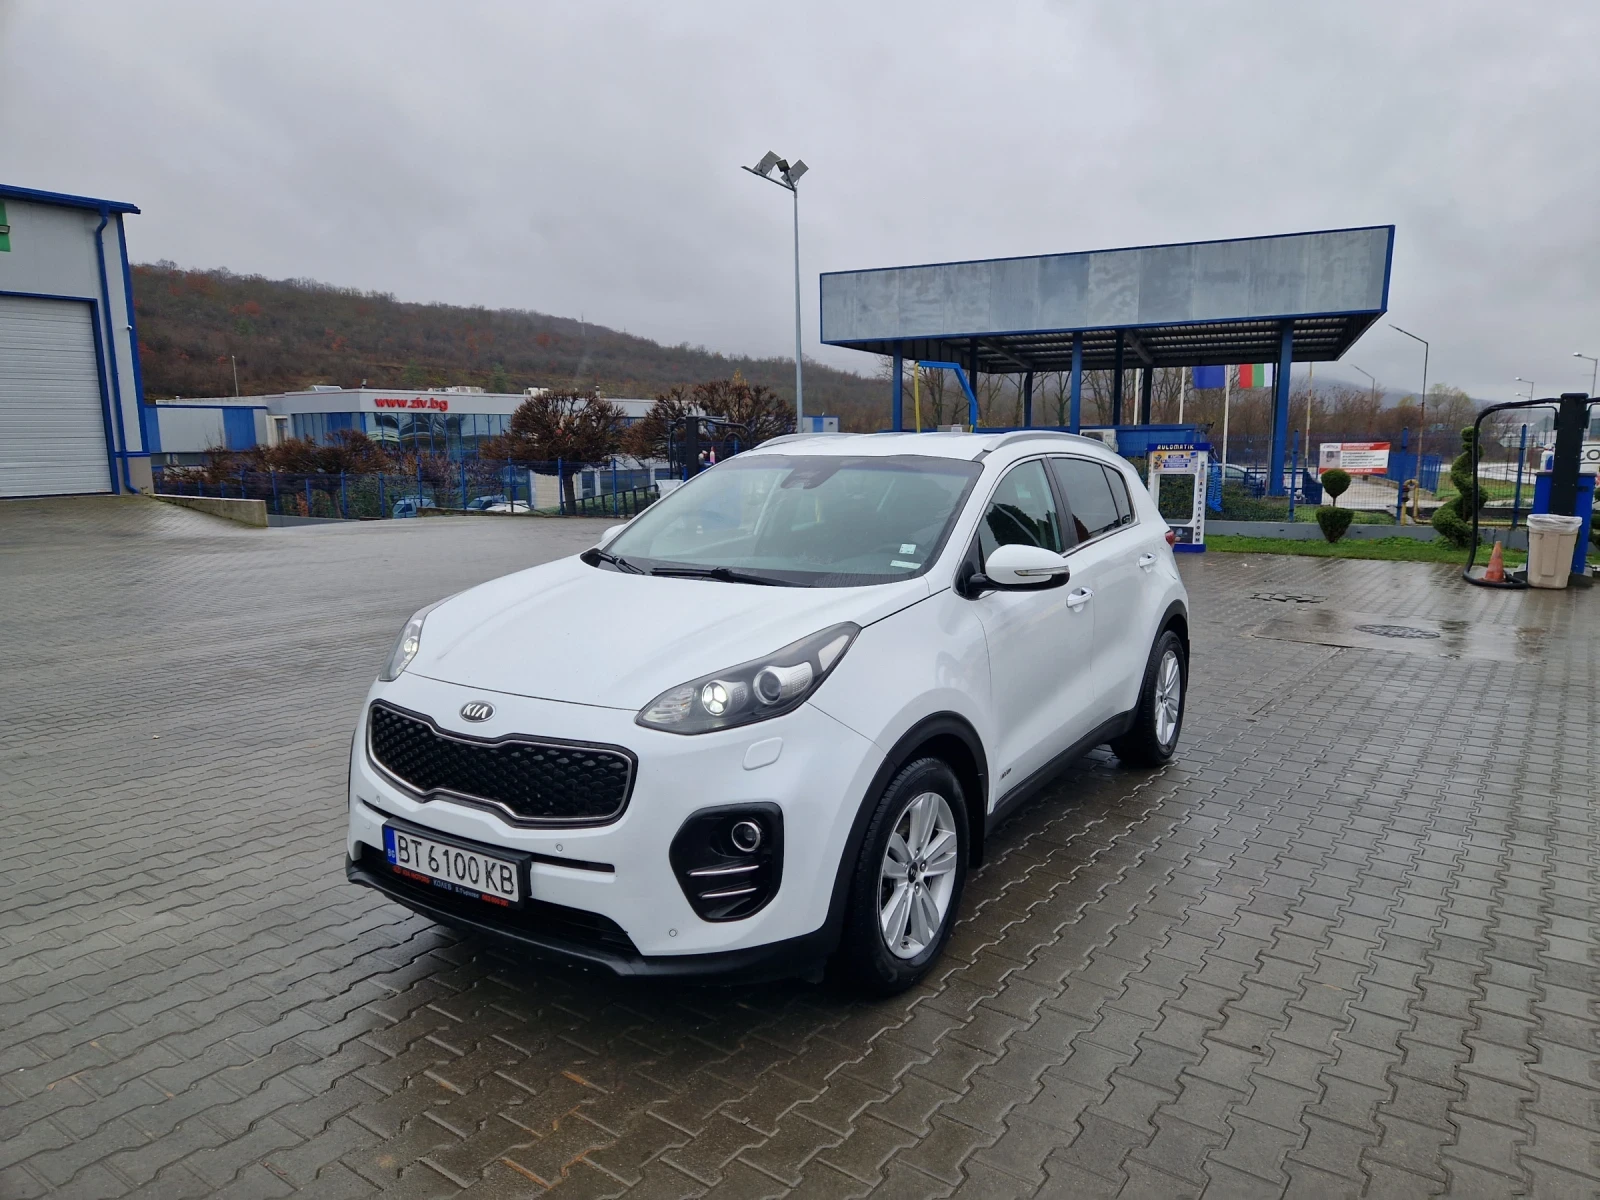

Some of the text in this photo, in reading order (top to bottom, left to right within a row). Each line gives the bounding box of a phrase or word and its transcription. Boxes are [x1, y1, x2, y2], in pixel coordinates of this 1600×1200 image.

[374, 397, 448, 412] www.ziv.bg
[462, 704, 488, 718] KIA
[387, 848, 396, 858] BG
[398, 835, 514, 895] BT 6100 KB
